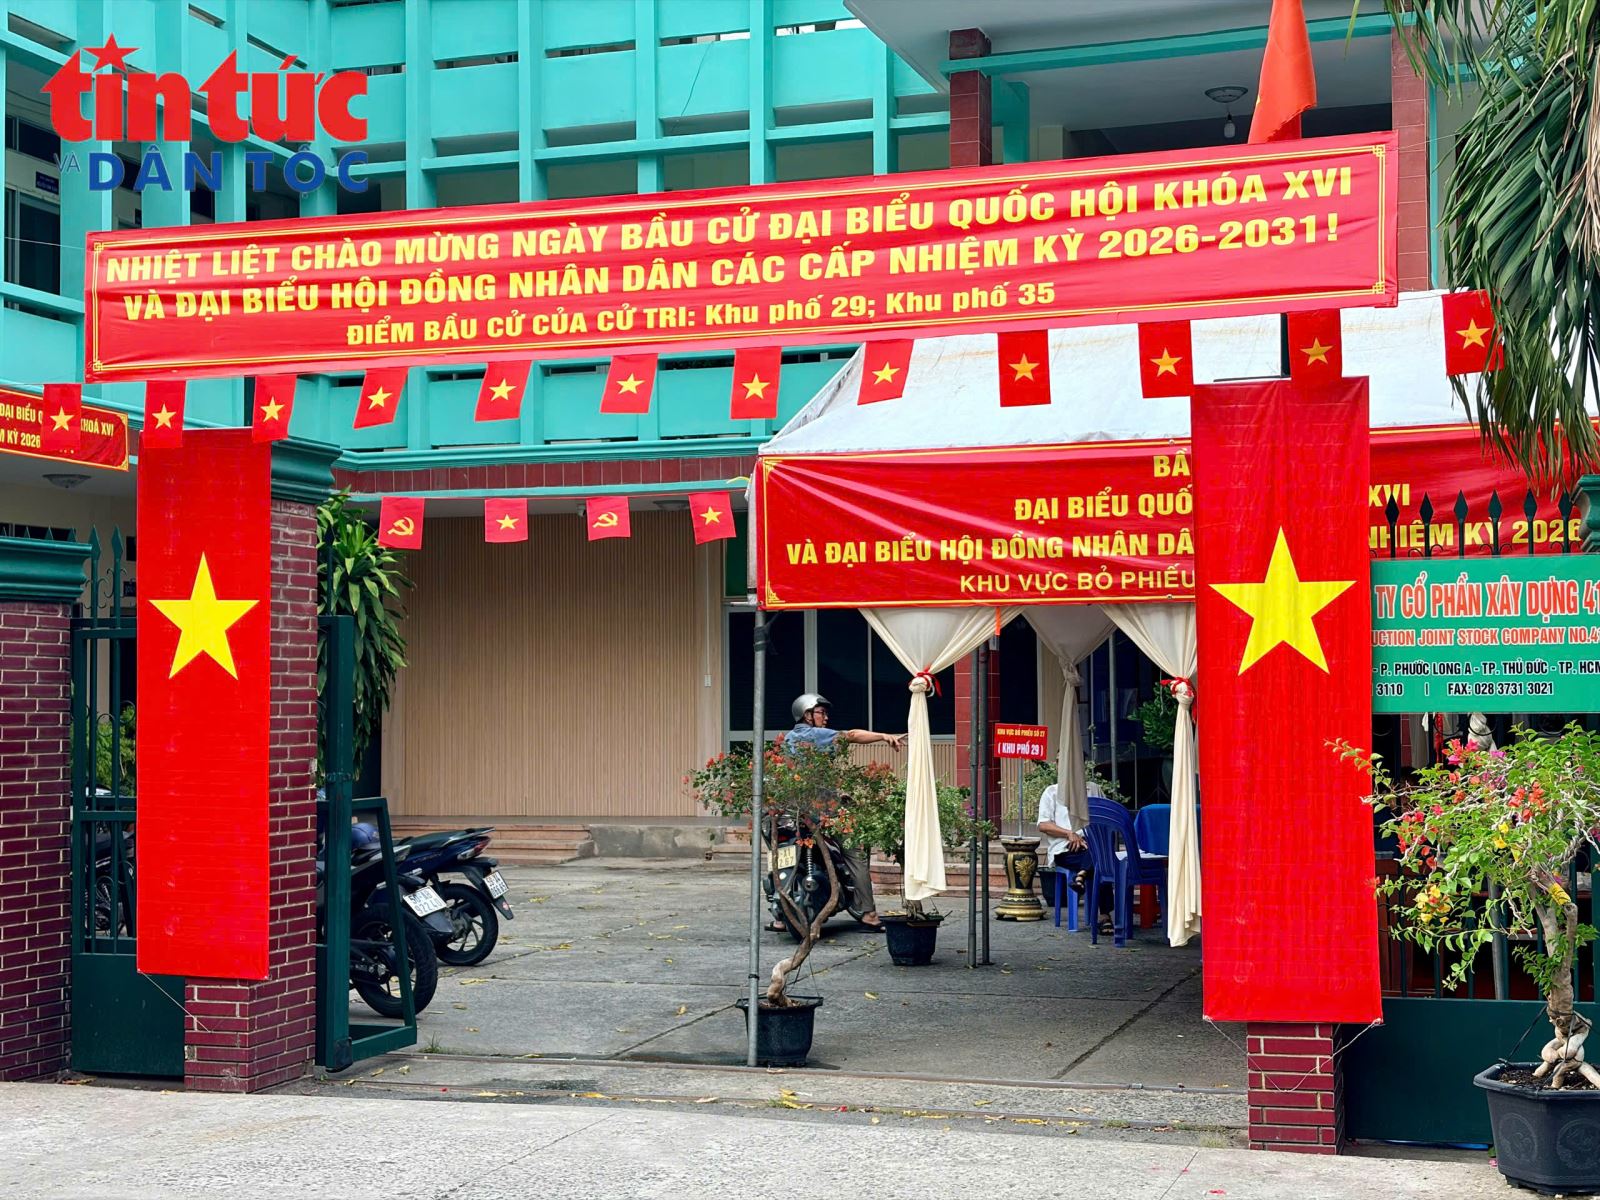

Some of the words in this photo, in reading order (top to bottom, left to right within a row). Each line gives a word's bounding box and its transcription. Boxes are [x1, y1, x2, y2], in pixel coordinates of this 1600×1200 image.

[105, 248, 203, 285] NHIỆT
[211, 243, 281, 280] LIỆT
[290, 237, 383, 272] CHÀO
[394, 231, 500, 265] MỪNG
[511, 222, 609, 258] NGÀY
[620, 212, 695, 251] BẦU
[707, 206, 761, 245] CỬ
[768, 209, 832, 245] ĐẠI
[846, 191, 935, 235] BIỂU
[948, 183, 1055, 230] QUỐC
[1070, 180, 1138, 222] HỘI
[1153, 171, 1267, 212] KHÓA
[1283, 166, 1352, 201] XVI
[123, 288, 166, 321] VÀ
[175, 289, 231, 322] ĐẠI
[241, 274, 319, 314] BIỂU
[330, 275, 389, 313] HỘI
[399, 267, 496, 305] ĐỒNG
[508, 263, 610, 299] NHÂN
[622, 257, 698, 292] DÂN
[711, 251, 785, 286] CÁC
[799, 240, 876, 281] CẤP
[889, 235, 1019, 276] NHIỆM
[1033, 227, 1085, 264] KỲ
[346, 314, 414, 346] ĐIỂM
[423, 312, 478, 342] BẦU
[487, 309, 527, 338] CỬ
[532, 306, 588, 336] CỦA
[597, 303, 638, 332] CỬ
[642, 306, 696, 329] TRI:
[705, 303, 759, 326] Khu
[769, 294, 823, 325] phố
[831, 295, 876, 319] 29;
[886, 291, 942, 314] Khu
[952, 281, 1009, 311] phố
[1017, 281, 1056, 306] 35
[7, 428, 18, 445] KỲ
[16, 403, 36, 423] BIỂU
[101, 421, 114, 437] XVI
[1014, 497, 1059, 525] ĐẠI
[1067, 486, 1129, 519] BIỂU
[786, 538, 818, 565] VÀ
[824, 541, 866, 568] ĐẠI
[875, 531, 932, 562] BIỂU
[939, 534, 983, 565] HỘI
[991, 531, 1064, 560] ĐỒNG
[1071, 530, 1148, 558] NHÂN
[960, 574, 1010, 593] KHU
[1018, 571, 1068, 595] VỰC
[1077, 565, 1113, 590] BỎ
[1375, 585, 1397, 618] TY
[1401, 571, 1428, 618] CỔ
[1430, 572, 1481, 617] PHẦN
[1486, 575, 1522, 616] XÂY
[1527, 576, 1579, 623] DỰNG
[1418, 629, 1454, 646] JOINT
[1458, 628, 1498, 645] STOCK
[1502, 627, 1567, 645] COMPANY
[1569, 626, 1600, 644] NO.4
[1380, 663, 1392, 676] P.
[1433, 662, 1461, 675] LONG
[1464, 662, 1472, 675] A
[1482, 662, 1500, 675] TP.
[1502, 658, 1523, 674] THỦ
[1526, 659, 1548, 674] ĐỨC
[1559, 661, 1577, 674] TP.
[1376, 683, 1403, 696] 3110
[1448, 683, 1472, 696] FAX:
[1474, 683, 1494, 696] 028
[1497, 682, 1523, 695] 3731
[1527, 682, 1553, 695] 3021
[1016, 740, 1030, 755] PHỐ
